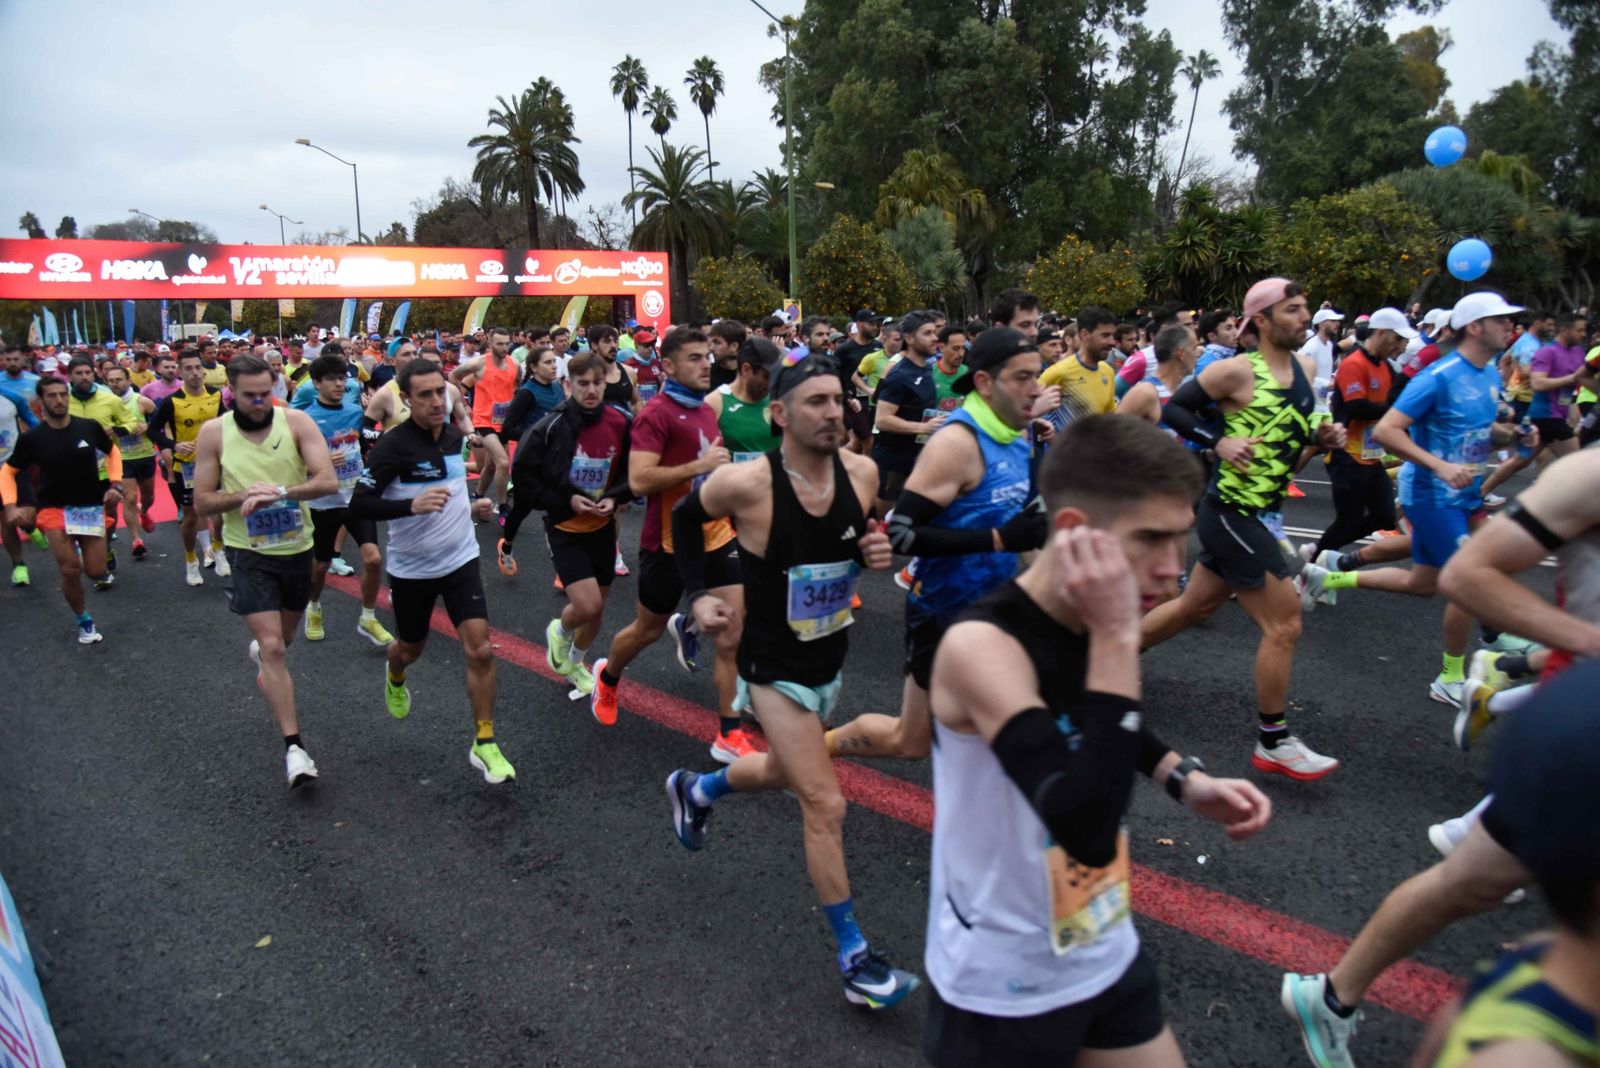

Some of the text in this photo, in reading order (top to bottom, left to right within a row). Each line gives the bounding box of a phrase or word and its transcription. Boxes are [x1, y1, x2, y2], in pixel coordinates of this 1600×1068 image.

[101, 260, 169, 281] HOKA
[574, 469, 604, 482] 1793
[255, 510, 292, 529] 3313
[802, 579, 849, 608] 3429
